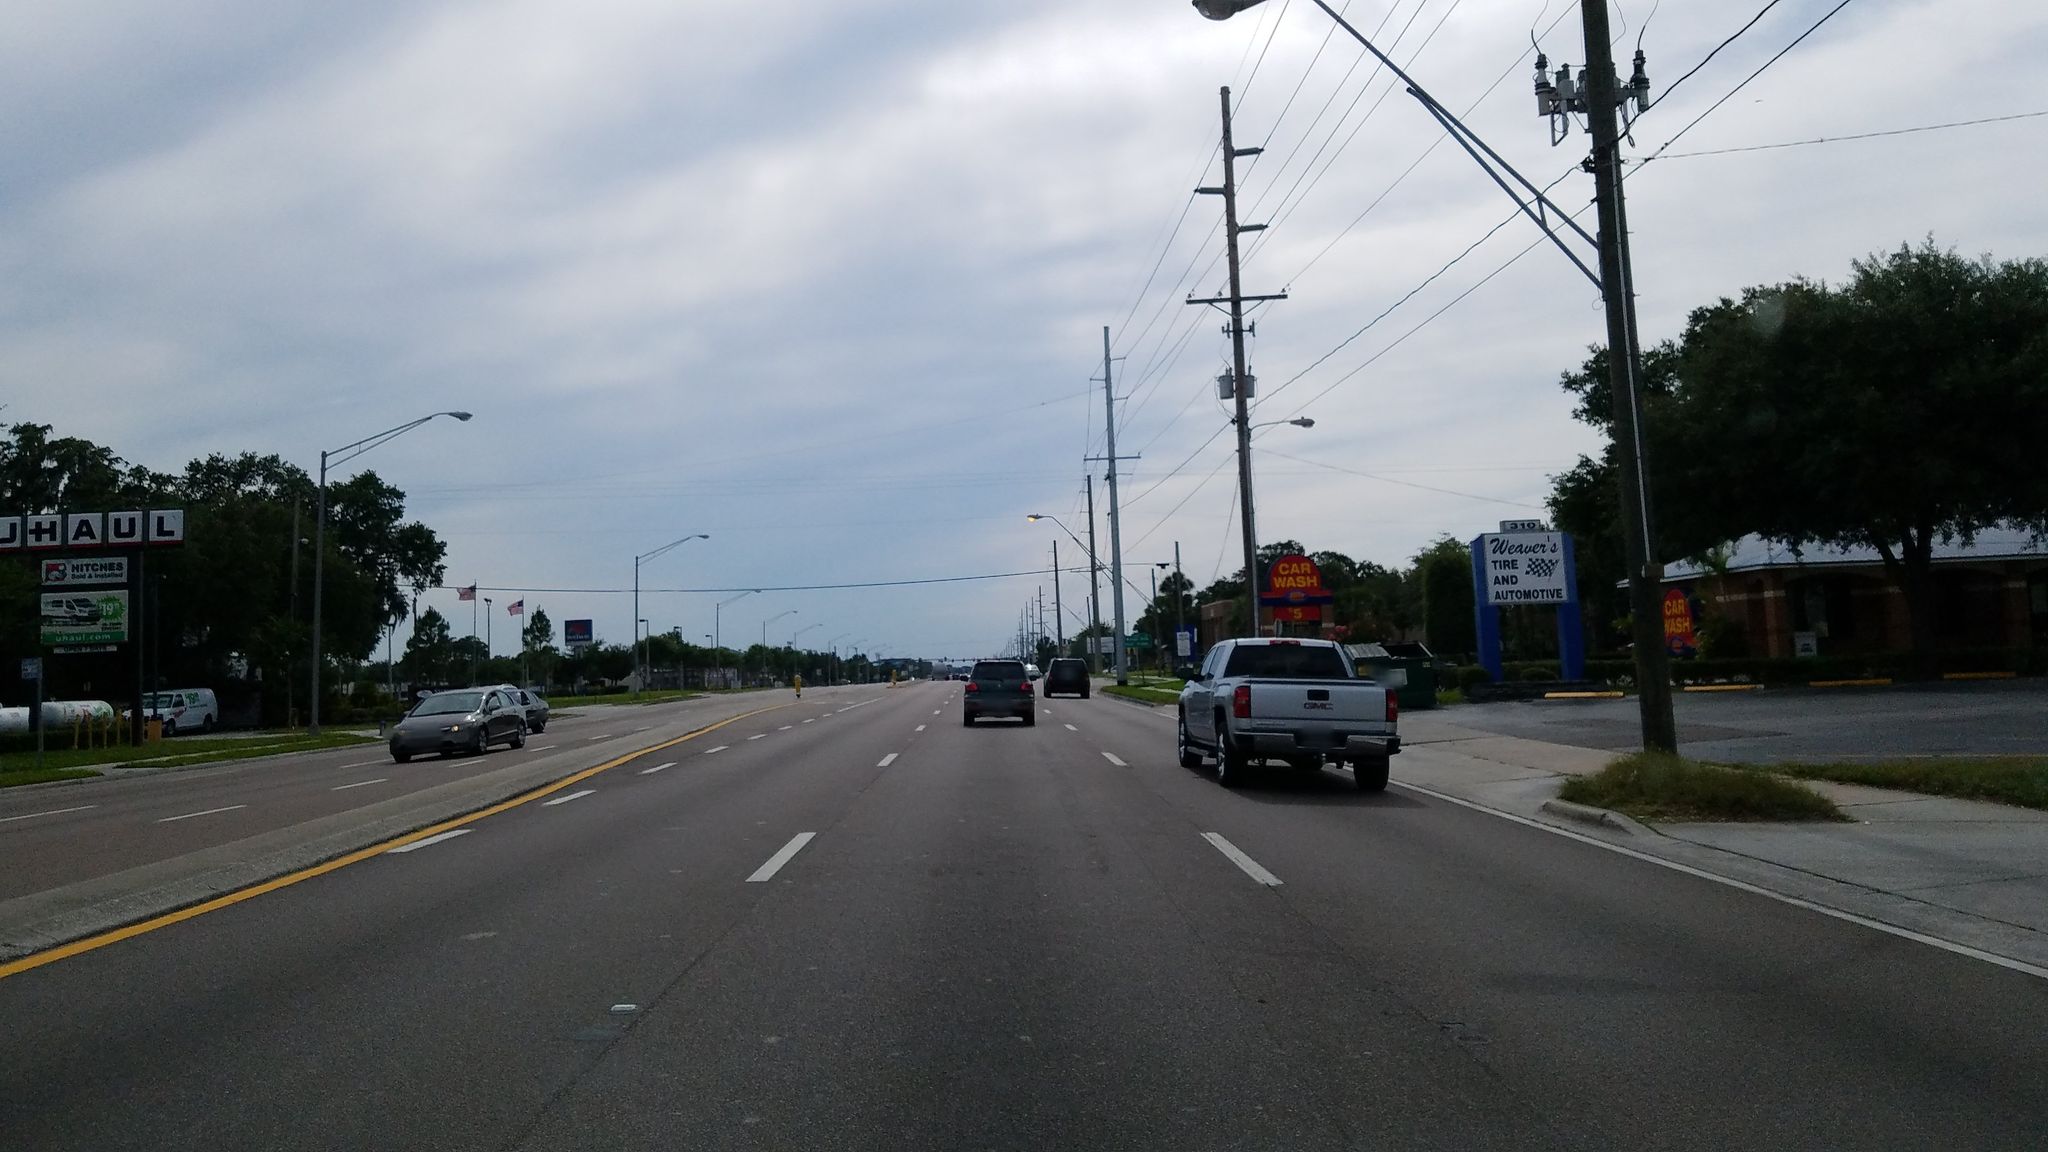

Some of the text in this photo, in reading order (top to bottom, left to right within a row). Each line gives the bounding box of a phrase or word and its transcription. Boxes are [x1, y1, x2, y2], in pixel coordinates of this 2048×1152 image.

[1510, 522, 1536, 530] 310
[1490, 535, 1559, 555] Weaver's
[71, 562, 124, 573] HITCHES
[1279, 562, 1311, 575] CAR
[1491, 559, 1519, 570] TIRE
[1273, 575, 1318, 588] WASH
[1493, 575, 1518, 586] AND
[1494, 588, 1563, 600] AUTOMOTIVE
[1664, 599, 1685, 616] CAR
[55, 633, 111, 642] uhaul.com
[1304, 702, 1334, 711] GMC
